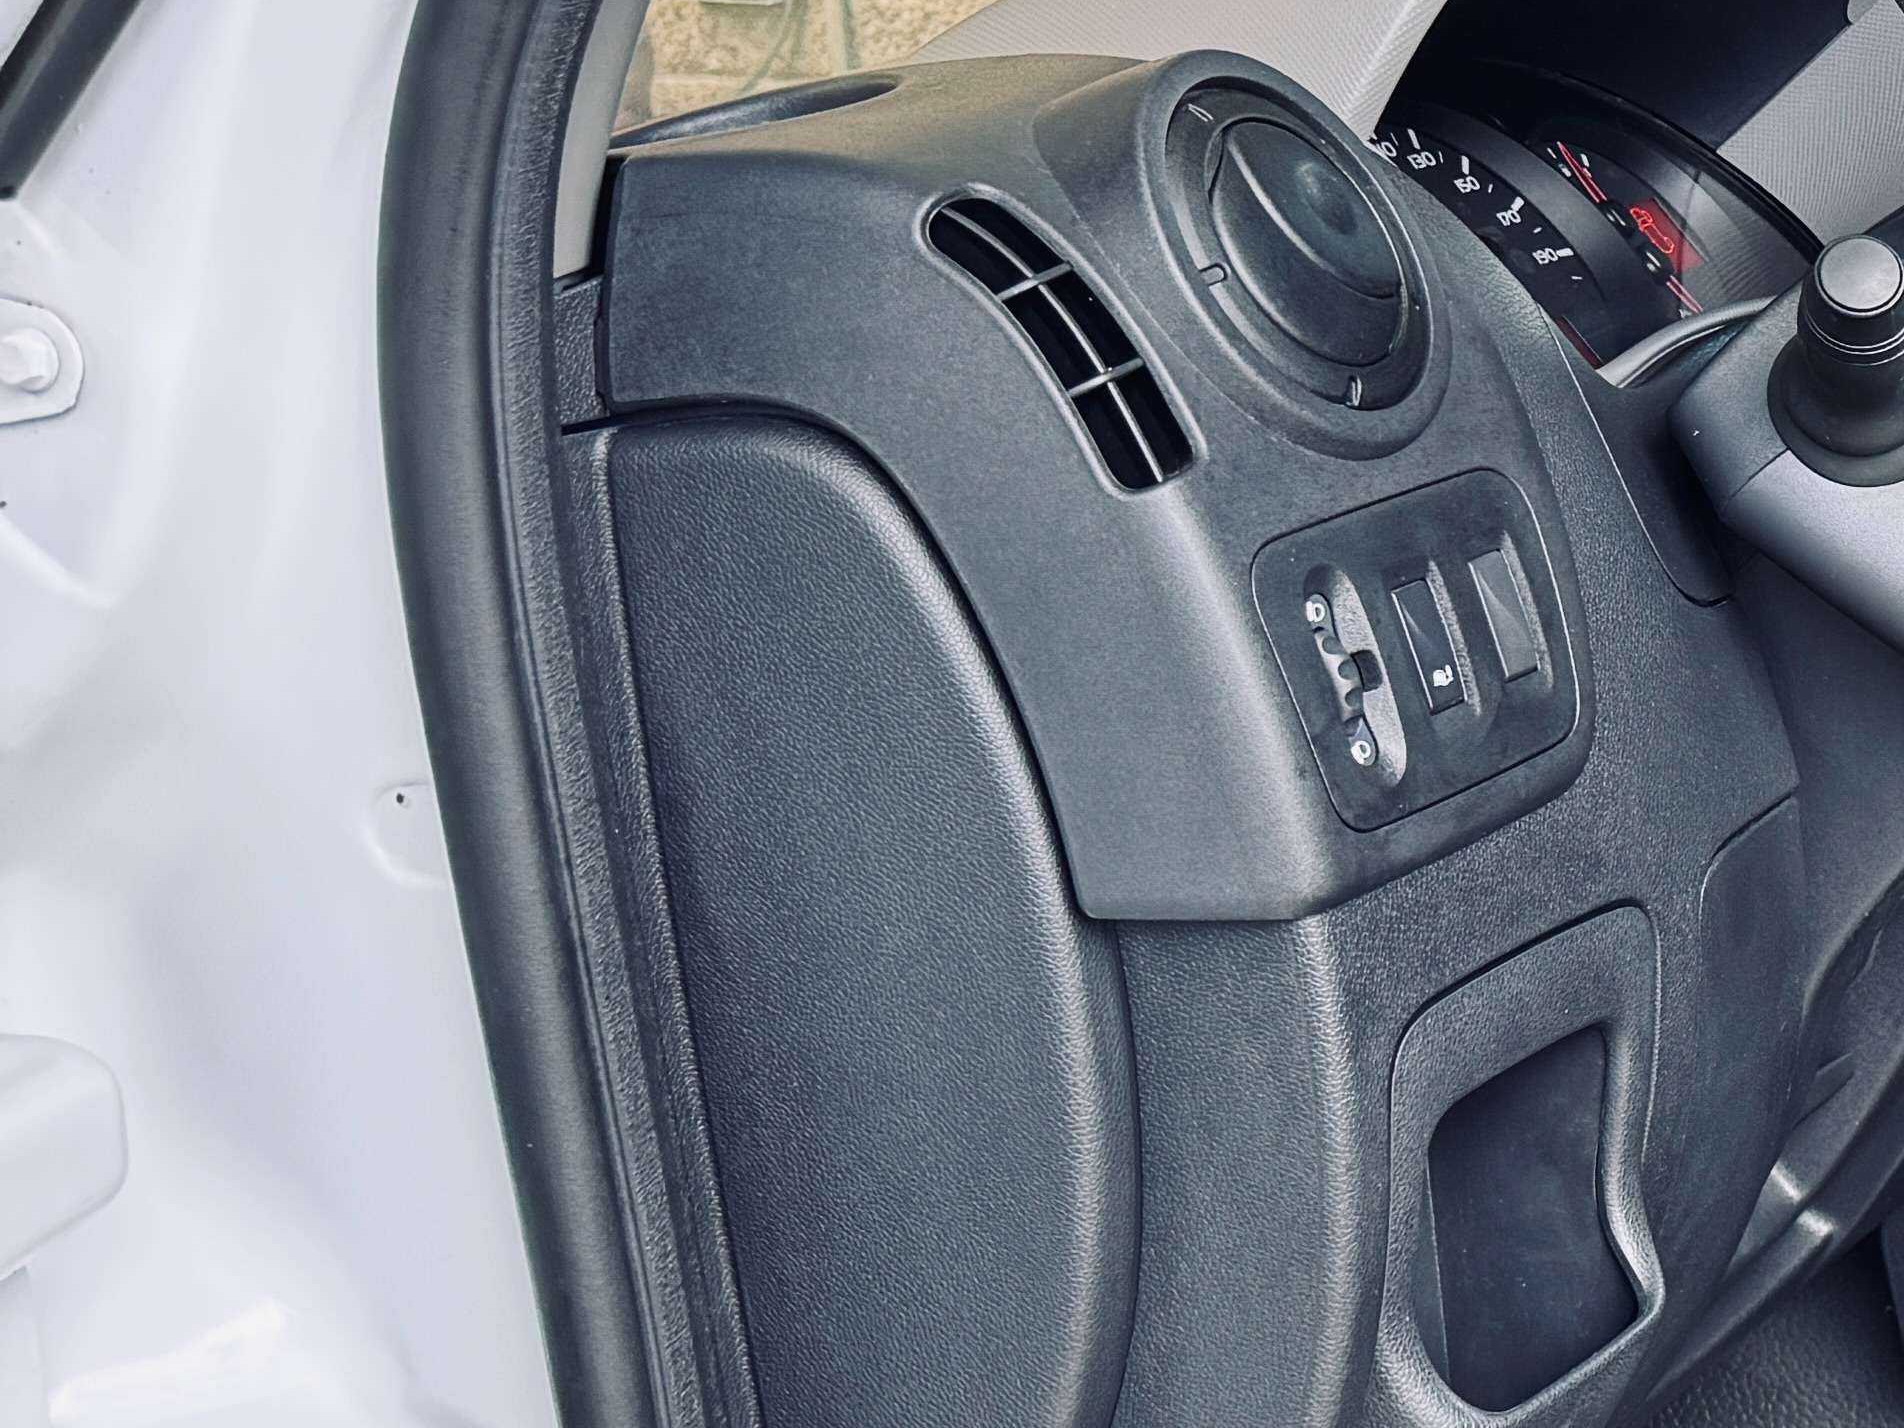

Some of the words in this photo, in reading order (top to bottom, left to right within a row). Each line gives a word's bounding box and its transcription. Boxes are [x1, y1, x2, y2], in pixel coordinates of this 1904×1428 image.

[1407, 151, 1437, 169] 130
[1453, 176, 1481, 193] 150
[1496, 210, 1522, 227] 170
[1532, 247, 1559, 265] 190
